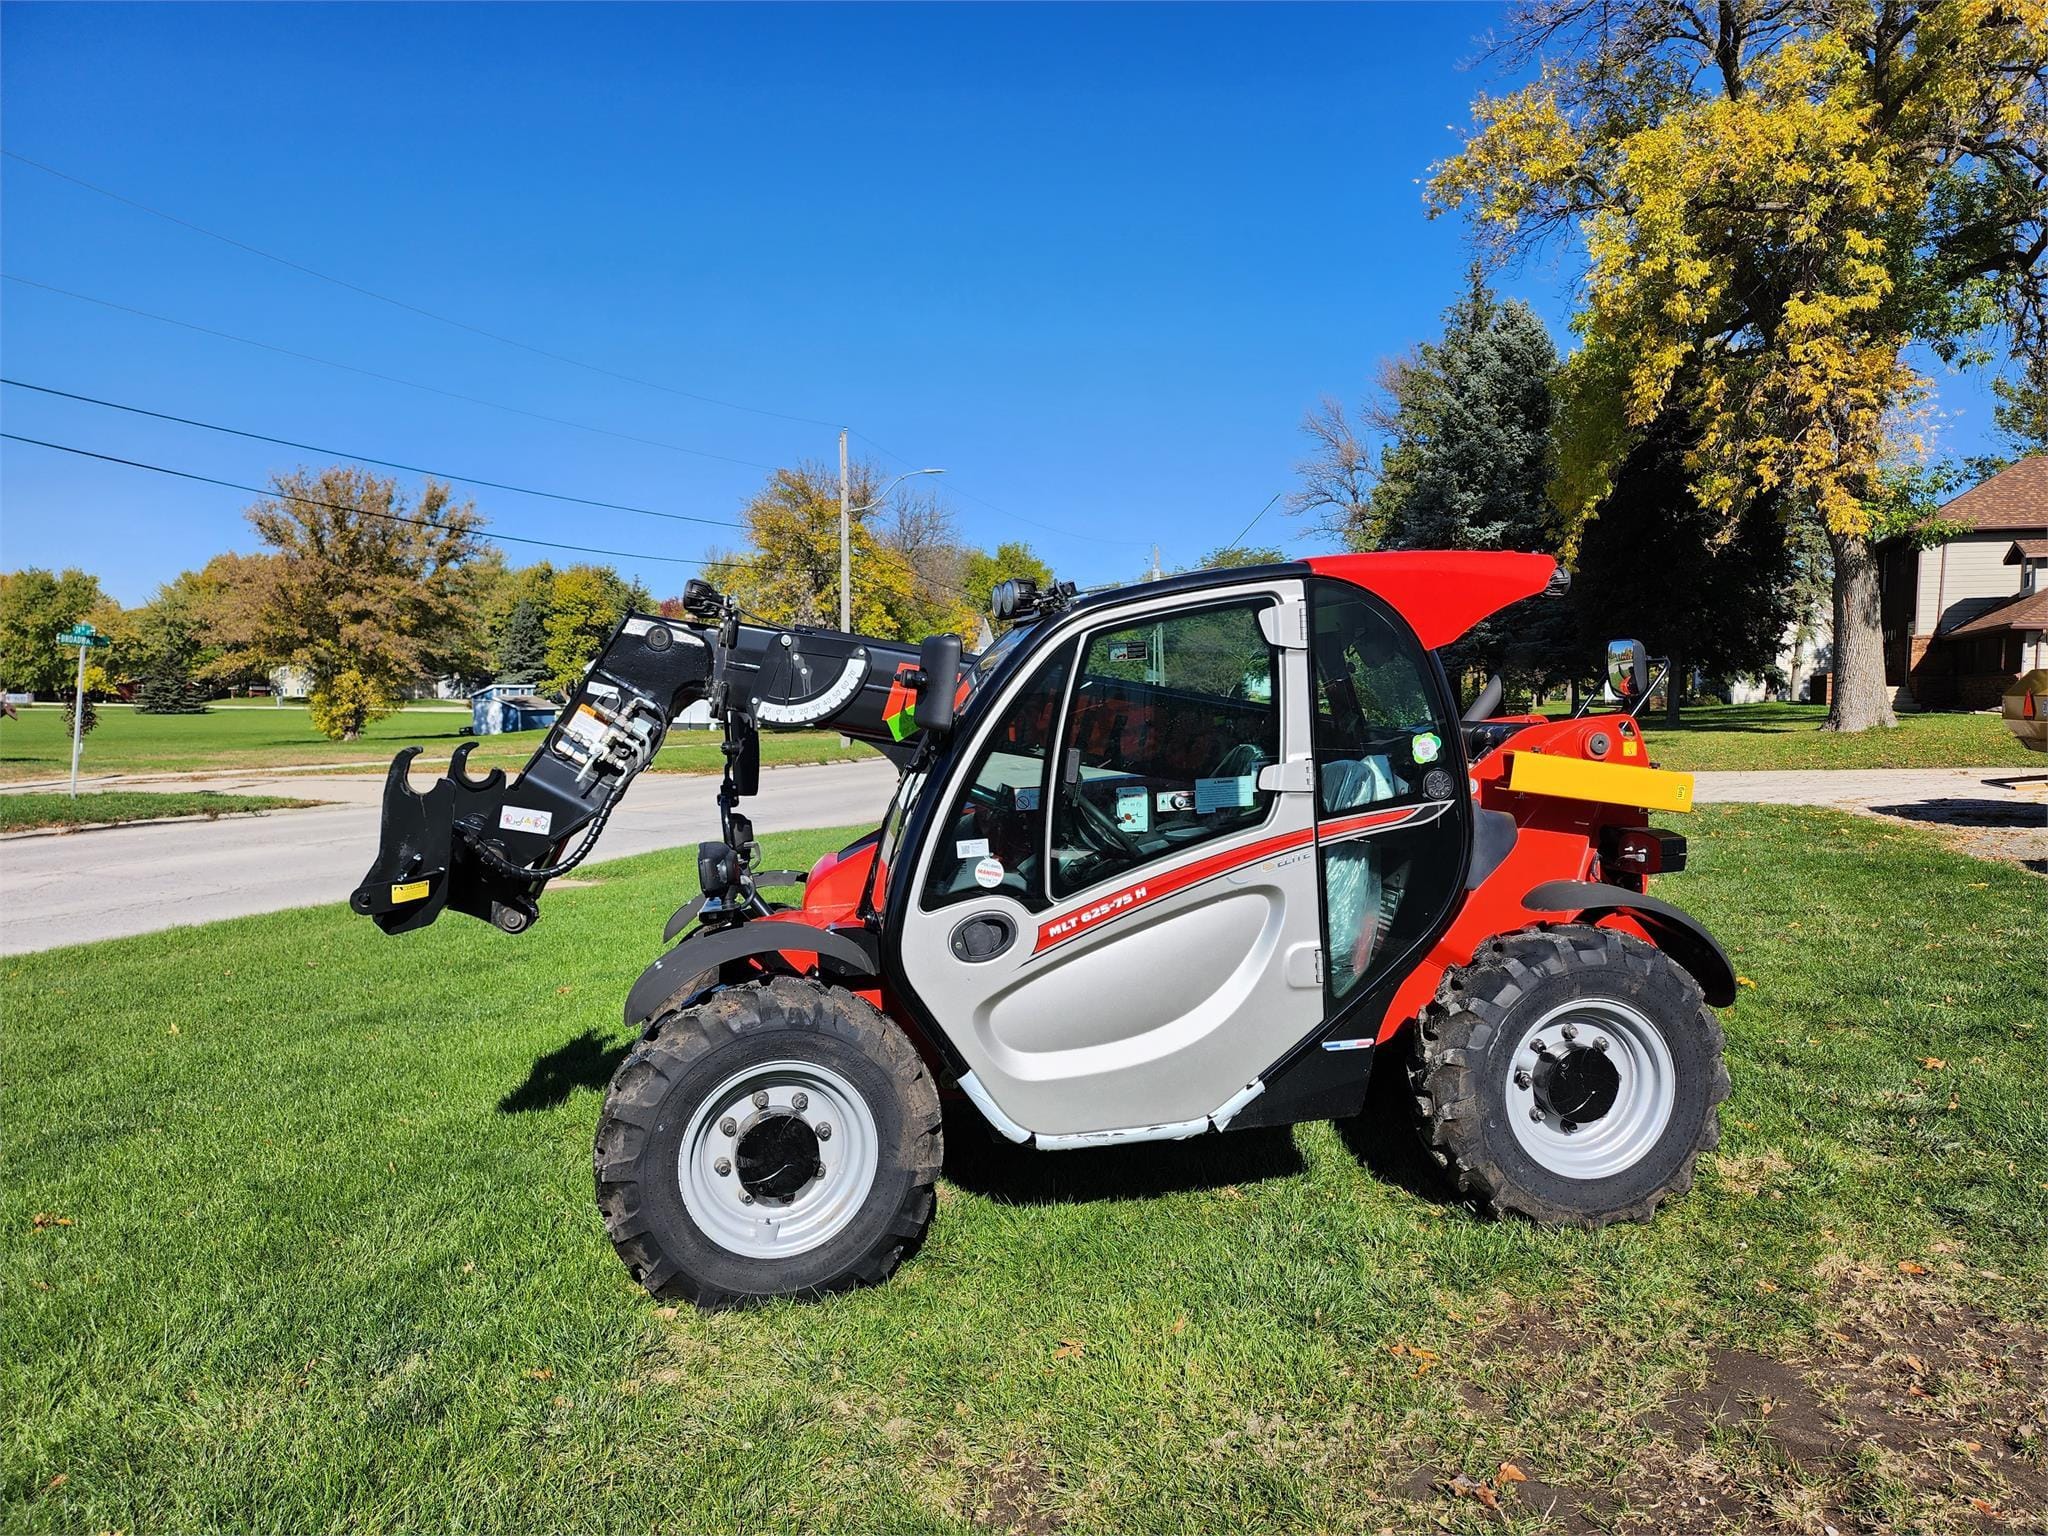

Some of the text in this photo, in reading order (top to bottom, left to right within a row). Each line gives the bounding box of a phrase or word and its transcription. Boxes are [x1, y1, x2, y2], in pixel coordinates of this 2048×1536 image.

[61, 634, 94, 646] BROADWAY
[1277, 852, 1311, 868] ELITE
[1049, 887, 1147, 937] MLT 625-75 H
